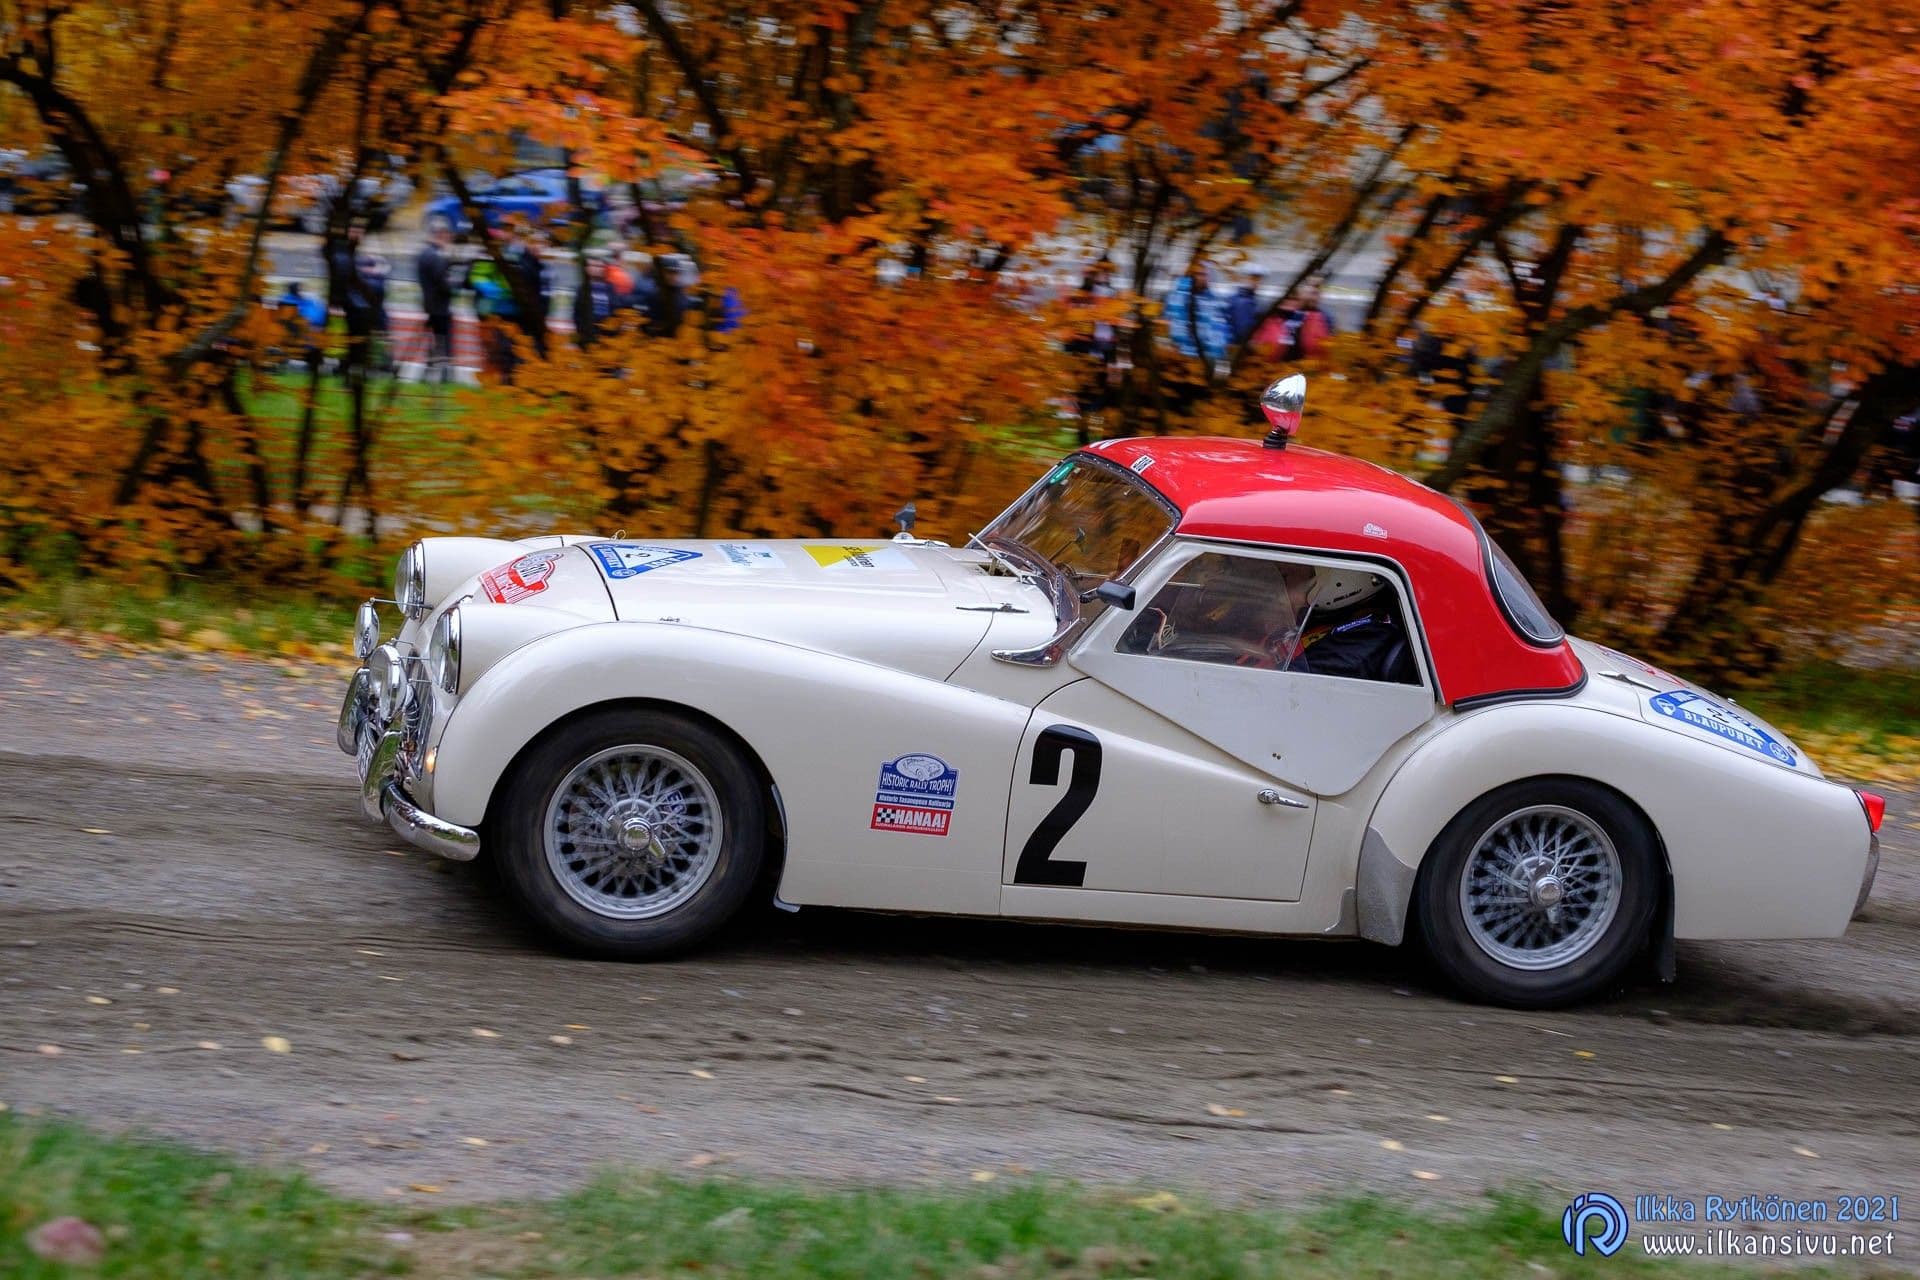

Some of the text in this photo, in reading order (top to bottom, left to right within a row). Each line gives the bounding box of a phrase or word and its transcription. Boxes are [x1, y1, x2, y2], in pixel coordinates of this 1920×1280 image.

[1683, 710, 1765, 750] BLAUPUNKT
[881, 772, 955, 793] HISTORIC RALLY TROPHY
[894, 808, 948, 829] HANAA!
[1013, 724, 1103, 887] 2
